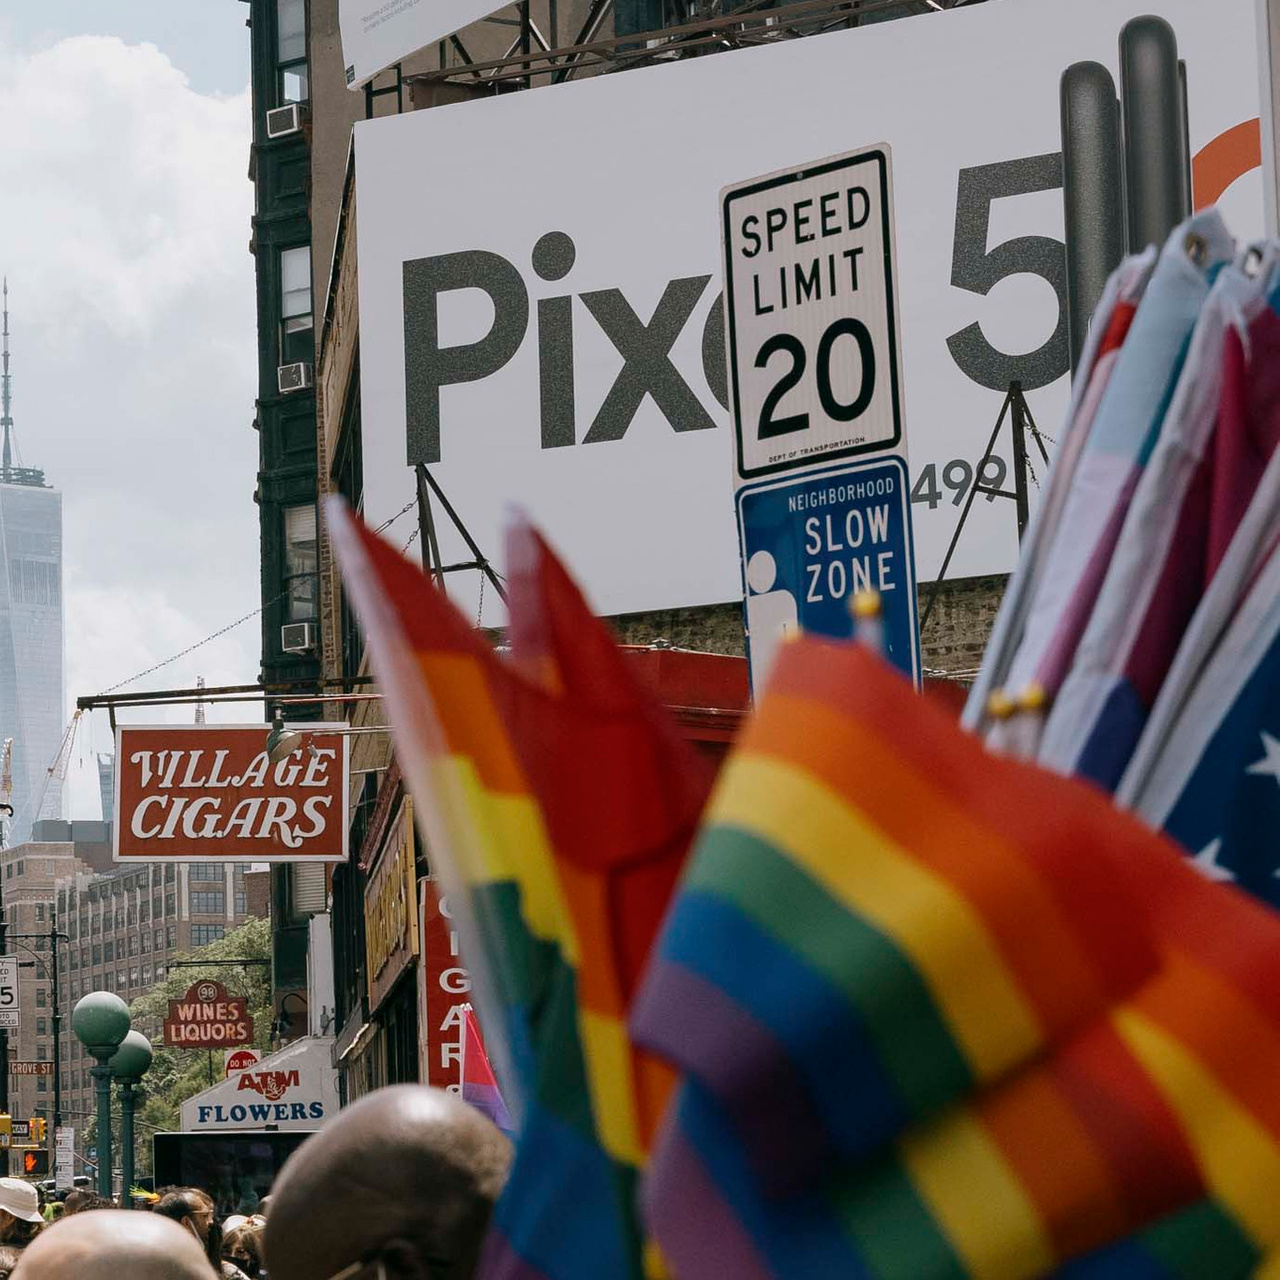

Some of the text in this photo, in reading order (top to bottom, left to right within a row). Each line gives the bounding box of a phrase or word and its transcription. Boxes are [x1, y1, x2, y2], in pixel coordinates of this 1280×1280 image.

[741, 186, 871, 259] SPEED
[754, 247, 864, 316] LIMIT
[946, 150, 1072, 393] 5
[402, 230, 732, 468] Pix
[754, 317, 876, 441] 20
[769, 436, 865, 463] DEPT OF TRANSPORTATION
[788, 477, 894, 512] NEIGHBORHOOD
[805, 503, 890, 556] SLOW
[806, 551, 896, 604] ZONE
[131, 749, 336, 788] VILLAGE
[131, 794, 333, 848] CIGARS
[177, 1002, 240, 1021] WINES
[200, 986, 215, 998] 98
[171, 1022, 247, 1042] LIQUORS
[12, 1063, 51, 1073] GROVE ST
[242, 1059, 257, 1067] NOT
[198, 1102, 324, 1123] FLOWERS
